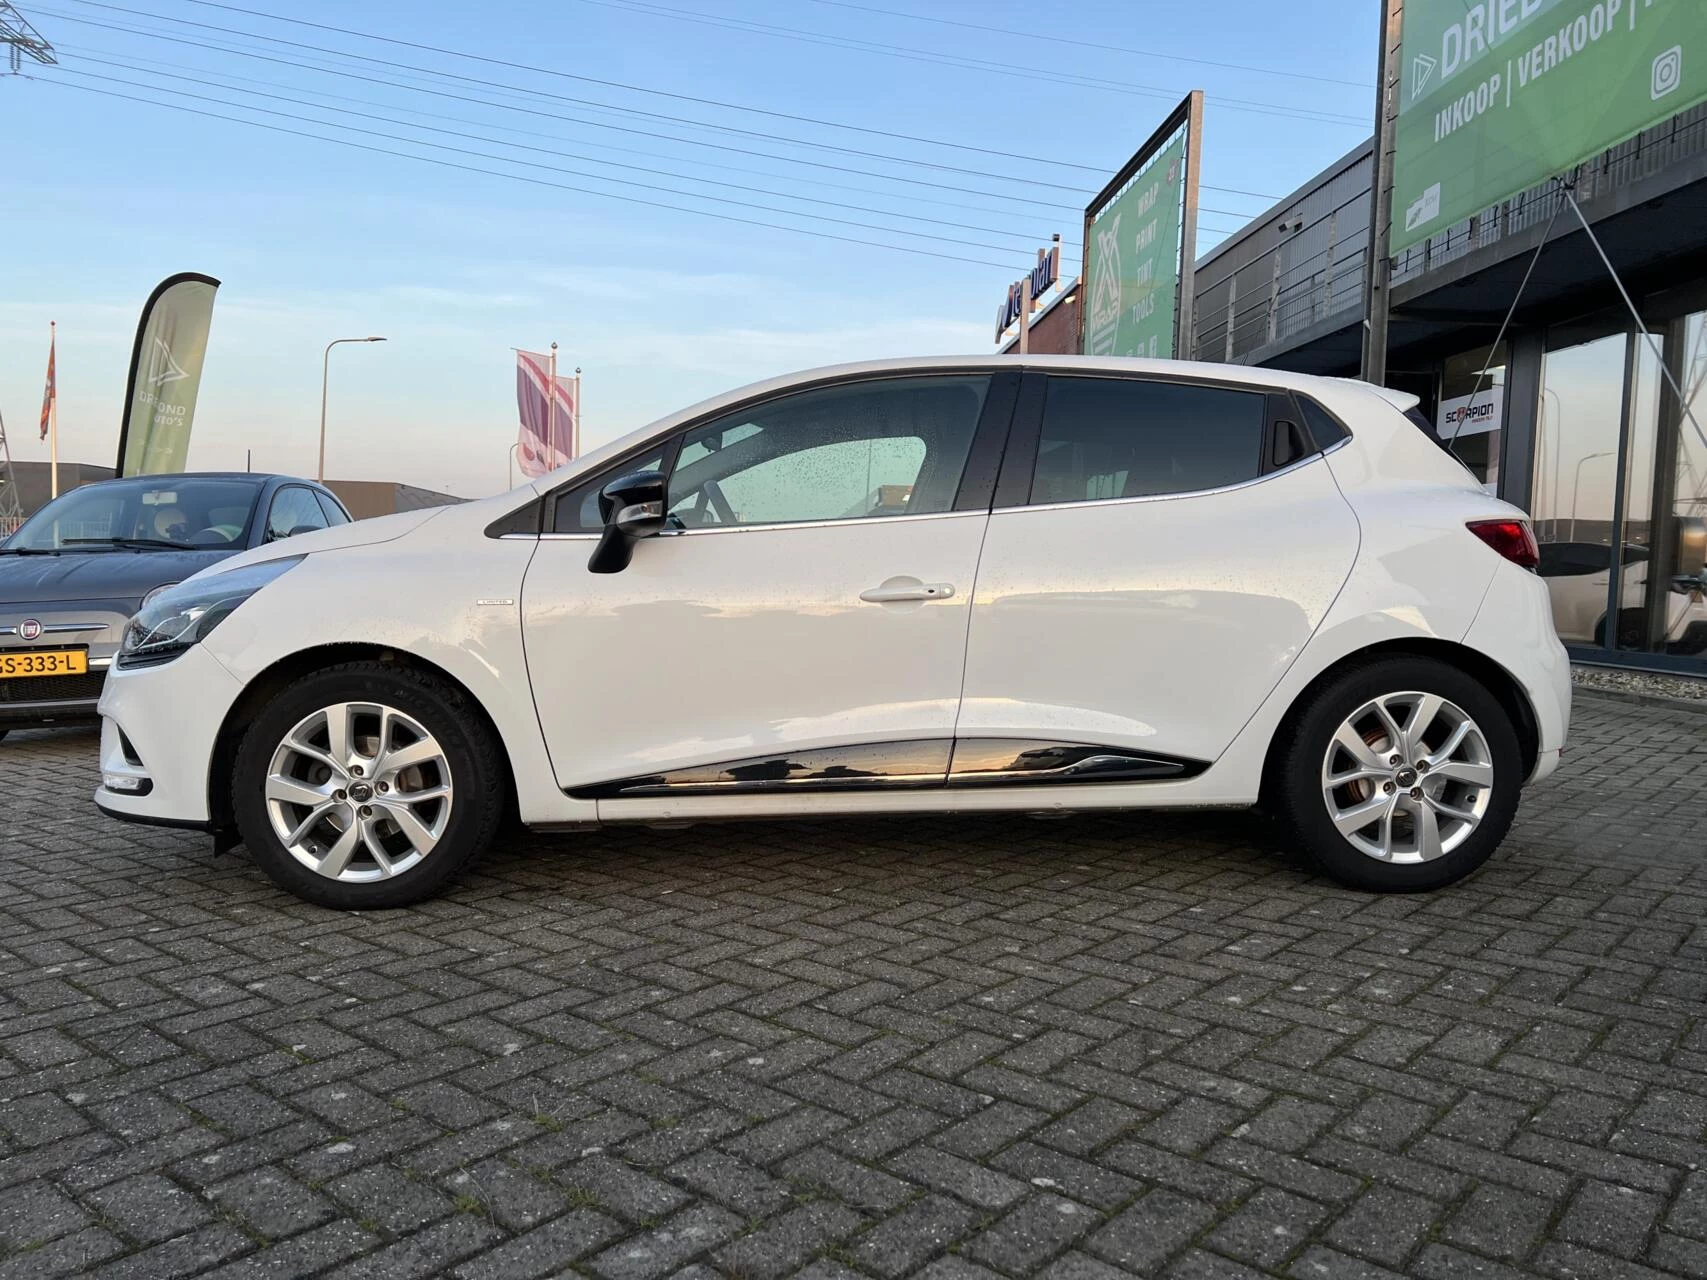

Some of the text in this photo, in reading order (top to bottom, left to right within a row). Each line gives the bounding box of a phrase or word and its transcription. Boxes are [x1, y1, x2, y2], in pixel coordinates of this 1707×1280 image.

[1442, 0, 1541, 79] DRIE
[1434, 0, 1621, 143] INKOOP VERKOOP
[1138, 182, 1158, 217] WRAP
[1136, 219, 1157, 253] PRINT
[1137, 259, 1152, 287] TINT
[1132, 293, 1154, 324] TOOLS
[0, 655, 76, 673] S-333-L
